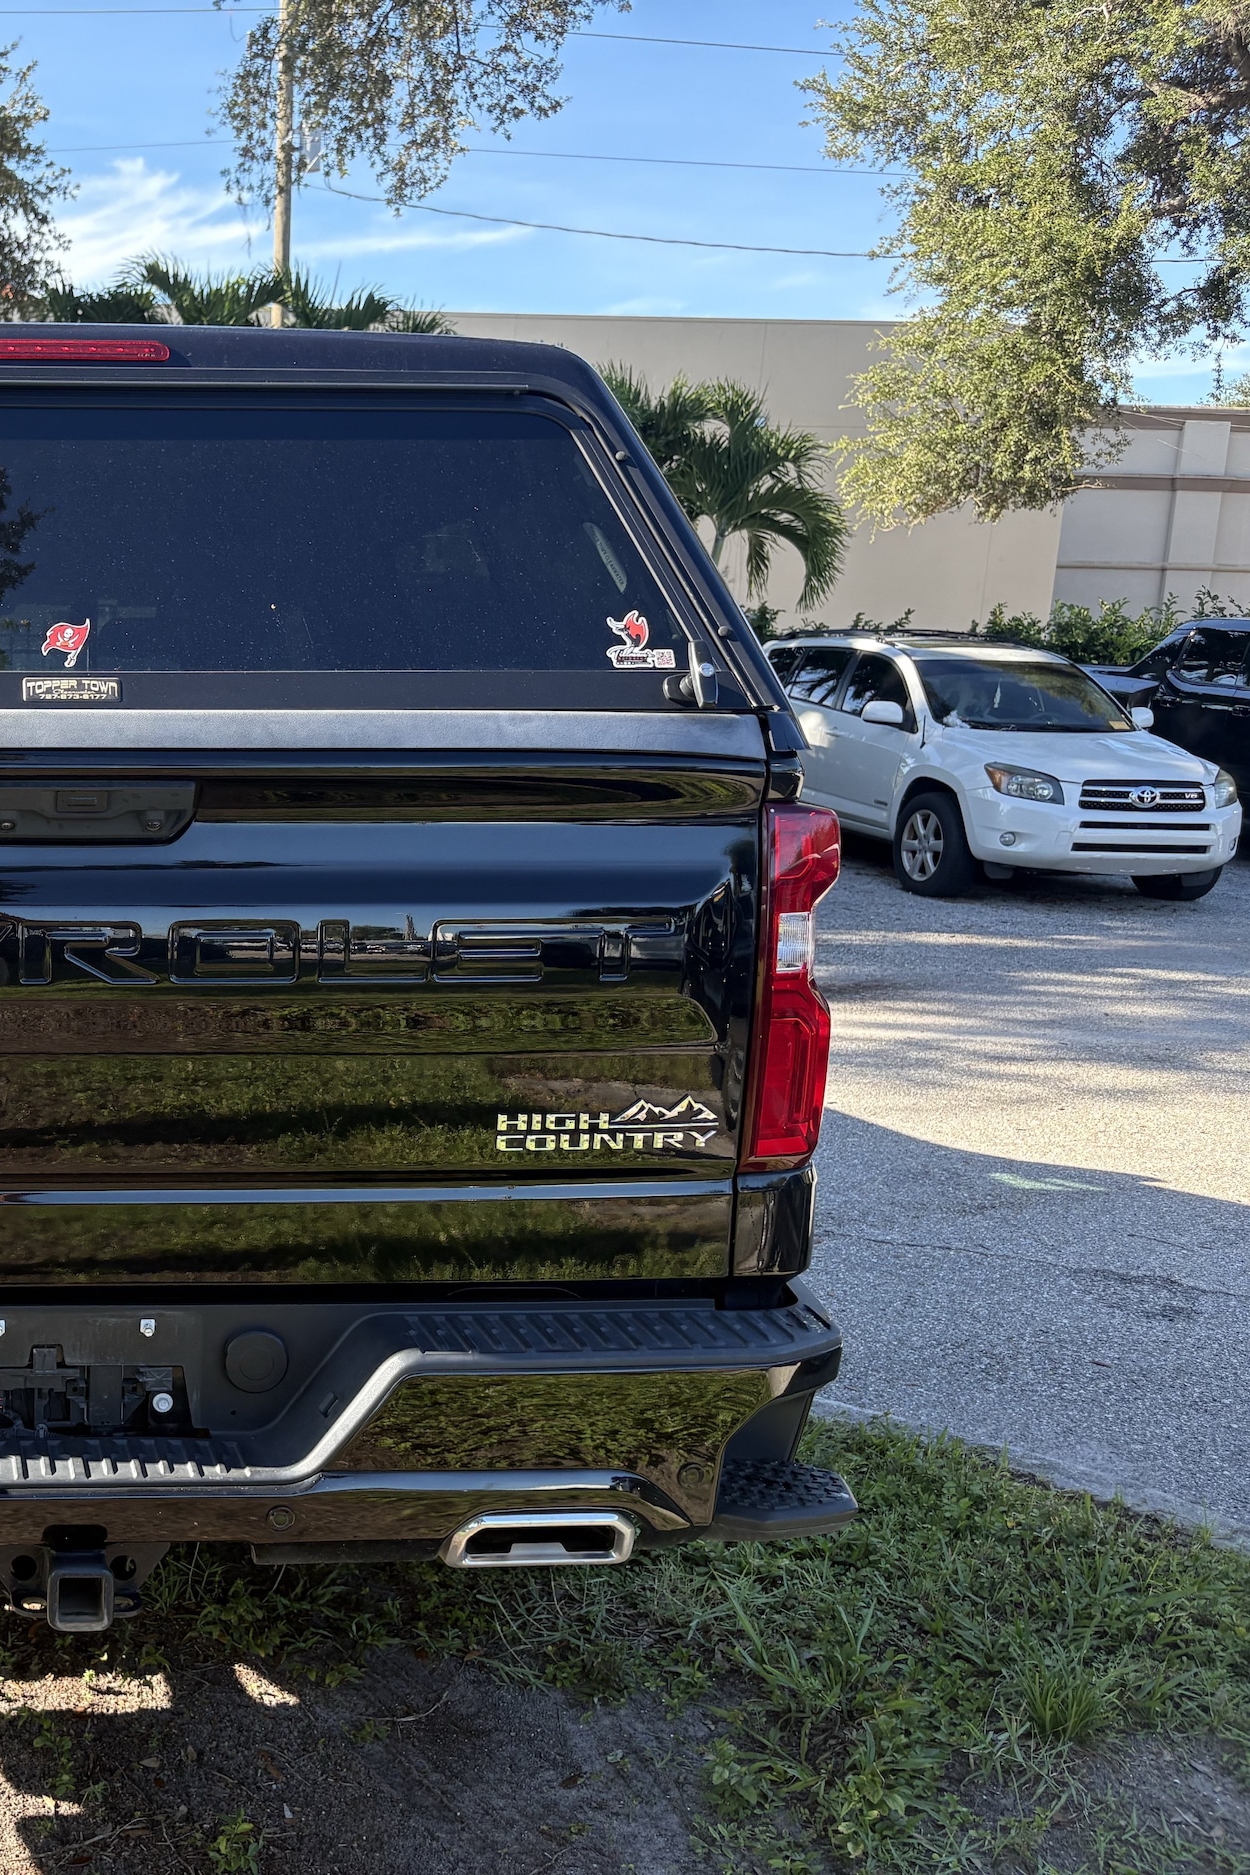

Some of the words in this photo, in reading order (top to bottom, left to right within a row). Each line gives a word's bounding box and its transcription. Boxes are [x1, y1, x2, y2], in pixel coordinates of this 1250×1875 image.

[27, 680, 77, 696] TOPPER
[82, 680, 118, 697] TOWN
[497, 1112, 610, 1131] HIGH
[495, 1130, 718, 1151] COUNTRY
